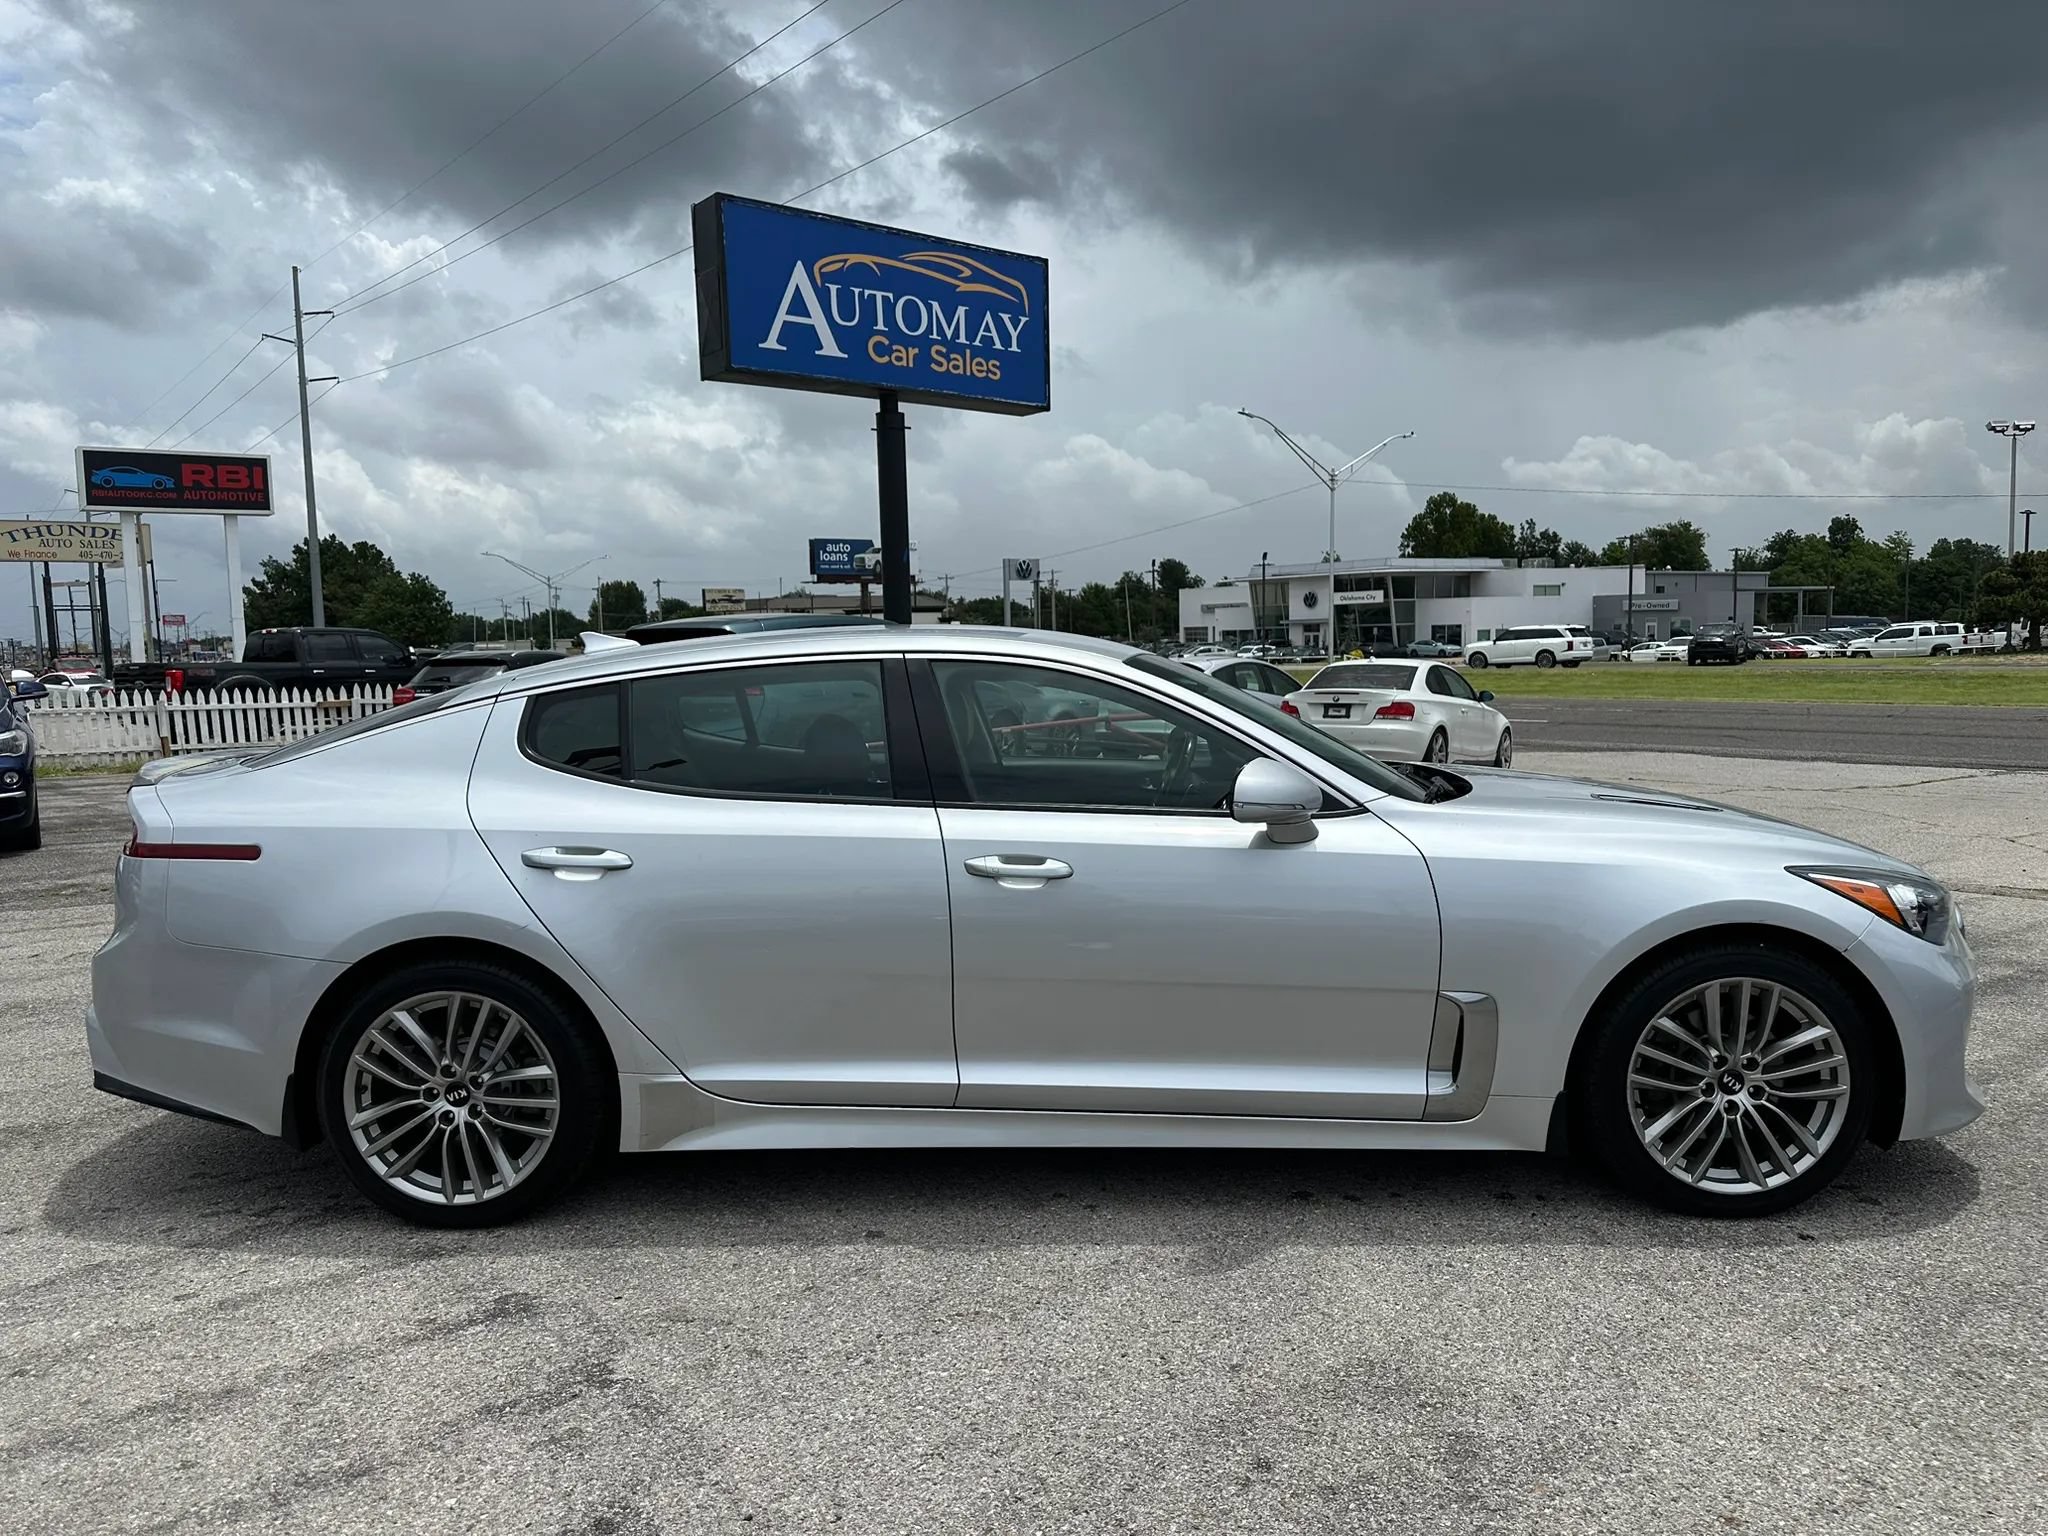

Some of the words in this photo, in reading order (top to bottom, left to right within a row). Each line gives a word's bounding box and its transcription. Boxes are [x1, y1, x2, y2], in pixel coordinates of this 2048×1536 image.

[758, 260, 1029, 358] AUTOMAY
[867, 335, 919, 368] Car
[929, 344, 1001, 380] Sales
[181, 463, 265, 489] RBI
[183, 490, 265, 502] AUTOMOTIVE
[0, 524, 123, 544] THUNDE
[38, 538, 73, 548] AUTO
[79, 539, 115, 549] SALES
[825, 543, 851, 553] auto
[8, 549, 20, 559] We
[24, 549, 58, 559] Finance
[820, 551, 848, 561] loans
[1339, 594, 1365, 602] Oklahoma
[1365, 593, 1377, 601] City
